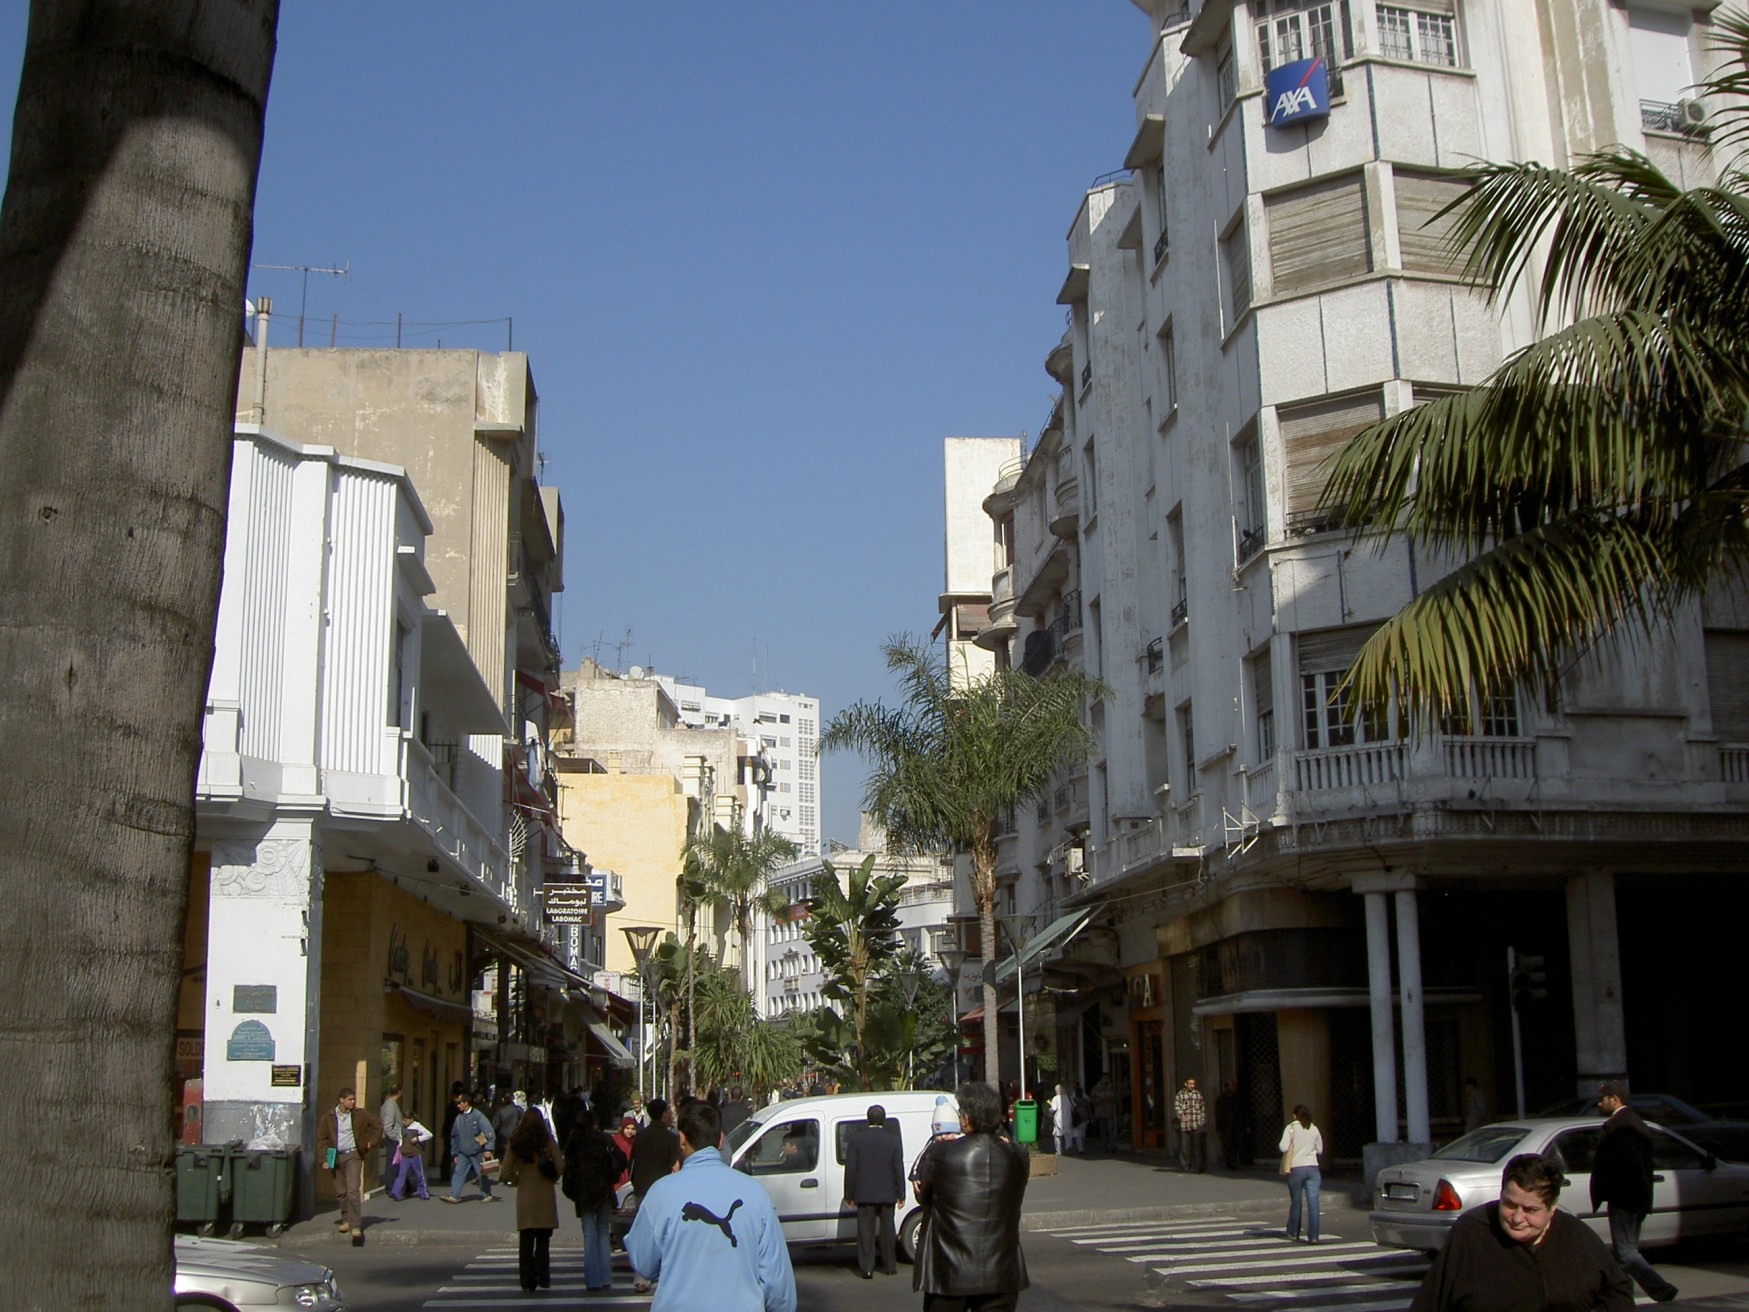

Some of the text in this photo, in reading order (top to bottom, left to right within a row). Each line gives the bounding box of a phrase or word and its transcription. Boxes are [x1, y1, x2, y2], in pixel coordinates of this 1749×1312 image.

[1271, 86, 1317, 122] AXA
[549, 887, 587, 896] مختبر
[546, 907, 588, 915] LABORATOIRE
